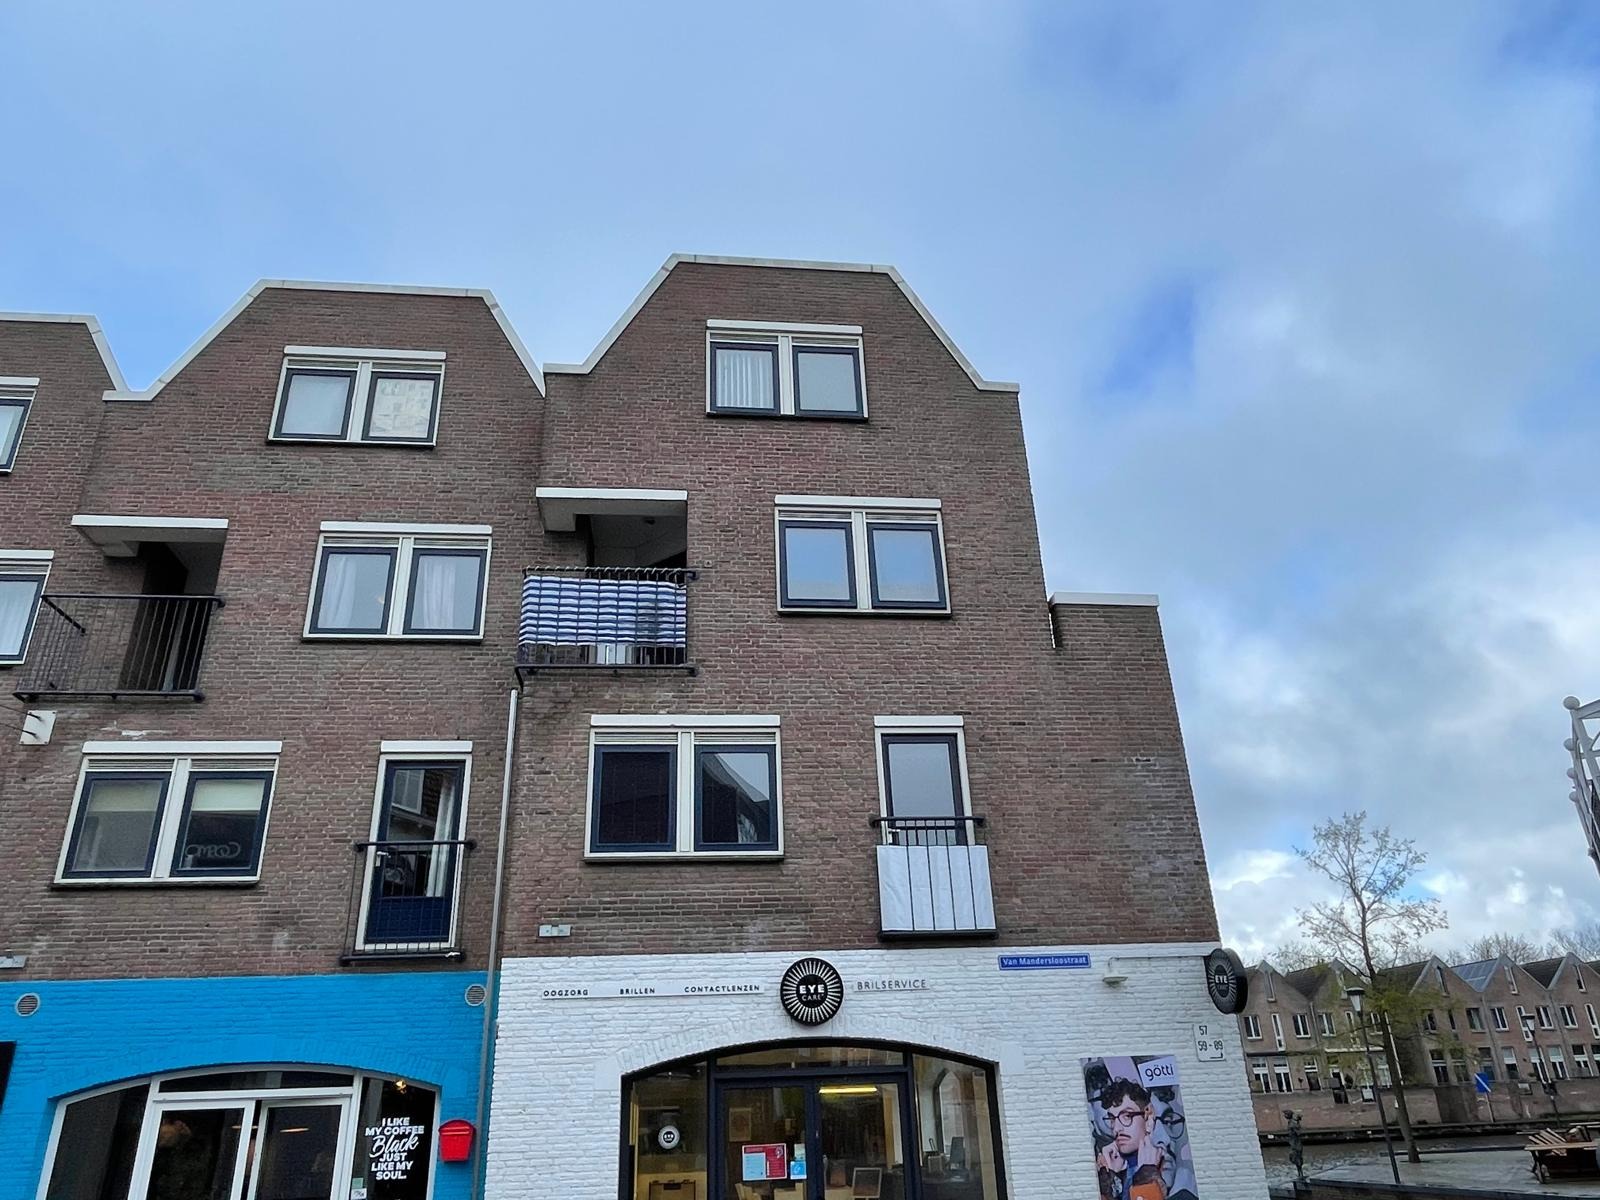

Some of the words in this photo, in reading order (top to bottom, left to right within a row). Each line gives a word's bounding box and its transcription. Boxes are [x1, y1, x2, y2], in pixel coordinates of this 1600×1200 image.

[1002, 958, 1018, 966] Van
[1019, 956, 1087, 966] Mandersloostraat
[543, 989, 589, 997] OOGZORG
[684, 984, 760, 993] CONTACTLENZEN
[799, 984, 825, 994] EYE
[857, 979, 926, 991] BRILSERVICE
[801, 994, 822, 1002] CARE
[1198, 1025, 1208, 1036] 57
[1144, 1064, 1174, 1082] götti
[382, 1118, 386, 1127] I
[387, 1117, 410, 1127] LIKE
[365, 1127, 382, 1136] MY
[384, 1125, 425, 1135] COFFEE
[369, 1131, 419, 1158] Black
[379, 1152, 408, 1162] JUST
[371, 1162, 395, 1172] LIKE
[395, 1161, 414, 1170] MY
[375, 1171, 407, 1180] SOUL.
